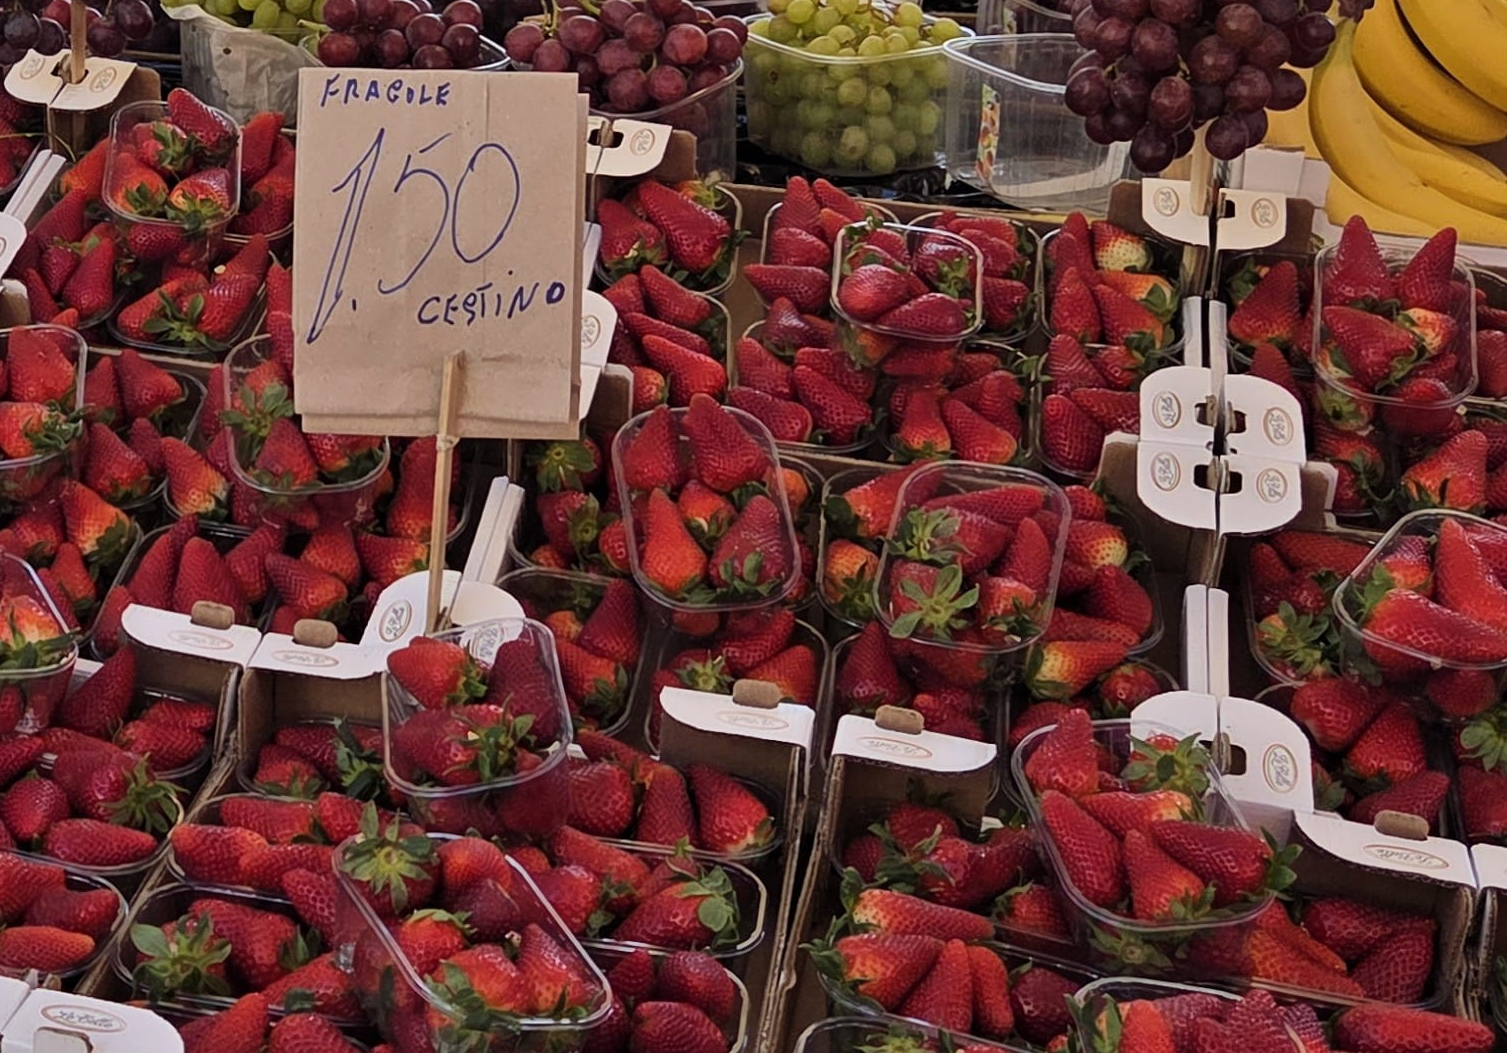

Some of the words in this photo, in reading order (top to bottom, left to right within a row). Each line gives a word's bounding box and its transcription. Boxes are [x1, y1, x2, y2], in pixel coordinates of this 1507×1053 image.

[320, 73, 452, 108] FRAGOLE
[306, 127, 521, 345] 1.50
[417, 270, 566, 327] CESTINO
